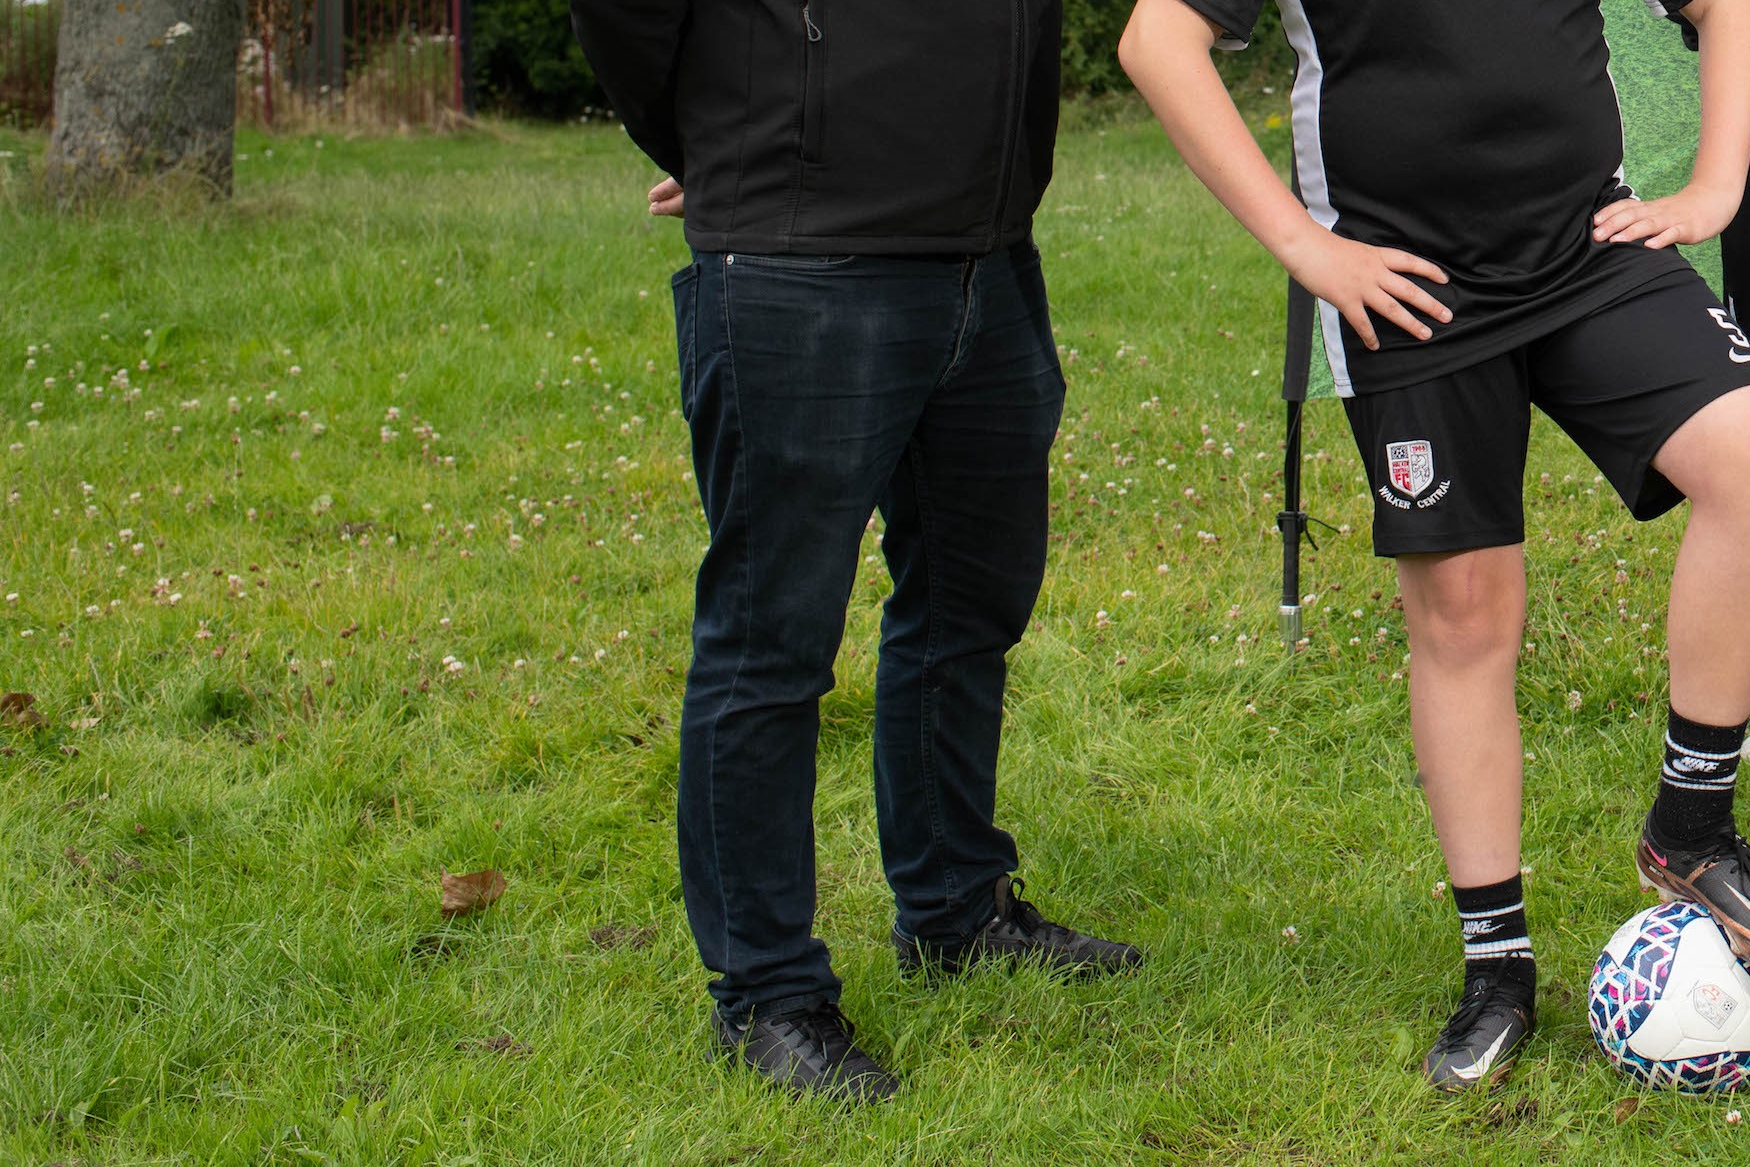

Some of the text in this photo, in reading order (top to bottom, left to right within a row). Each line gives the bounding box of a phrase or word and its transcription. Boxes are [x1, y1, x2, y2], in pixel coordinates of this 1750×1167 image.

[1706, 308, 1750, 348] 5
[1394, 472, 1411, 491] FC
[1378, 480, 1451, 510] WALKER CENTRAL
[1680, 756, 1720, 773] NIKE
[1463, 919, 1492, 935] NIKE
